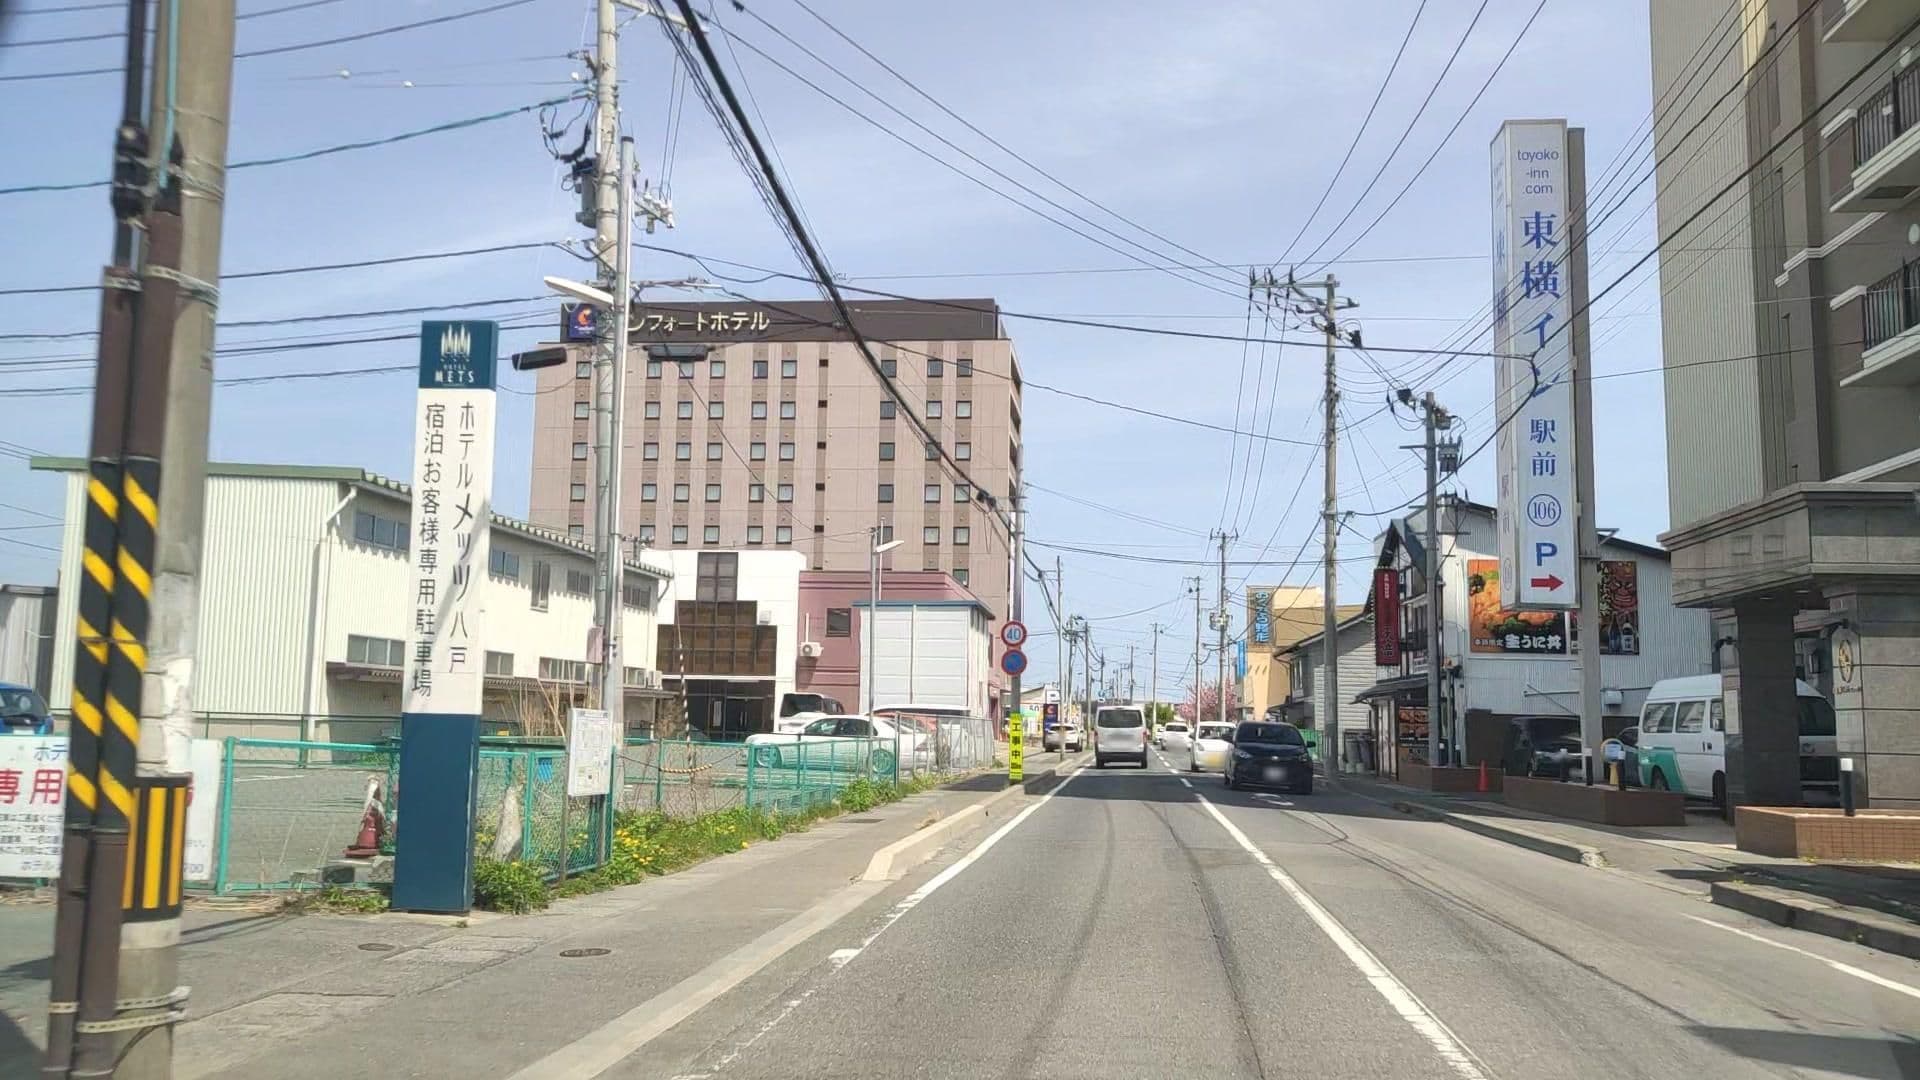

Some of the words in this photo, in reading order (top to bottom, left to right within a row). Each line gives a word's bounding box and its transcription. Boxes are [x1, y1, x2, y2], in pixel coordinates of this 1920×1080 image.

[1517, 149, 1559, 163] toyoko
[1526, 168, 1549, 179] -inn
[1522, 183, 1553, 194] .com
[628, 312, 770, 332] ンフォートホテル
[435, 370, 475, 383] METS
[1530, 418, 1556, 477] 駅前
[1532, 501, 1556, 520] 106
[449, 401, 475, 673] ホテルメッツ八戸
[411, 403, 446, 697] 宿泊お客様専用駐車場
[1535, 542, 1558, 567] P
[1006, 628, 1021, 641] 40
